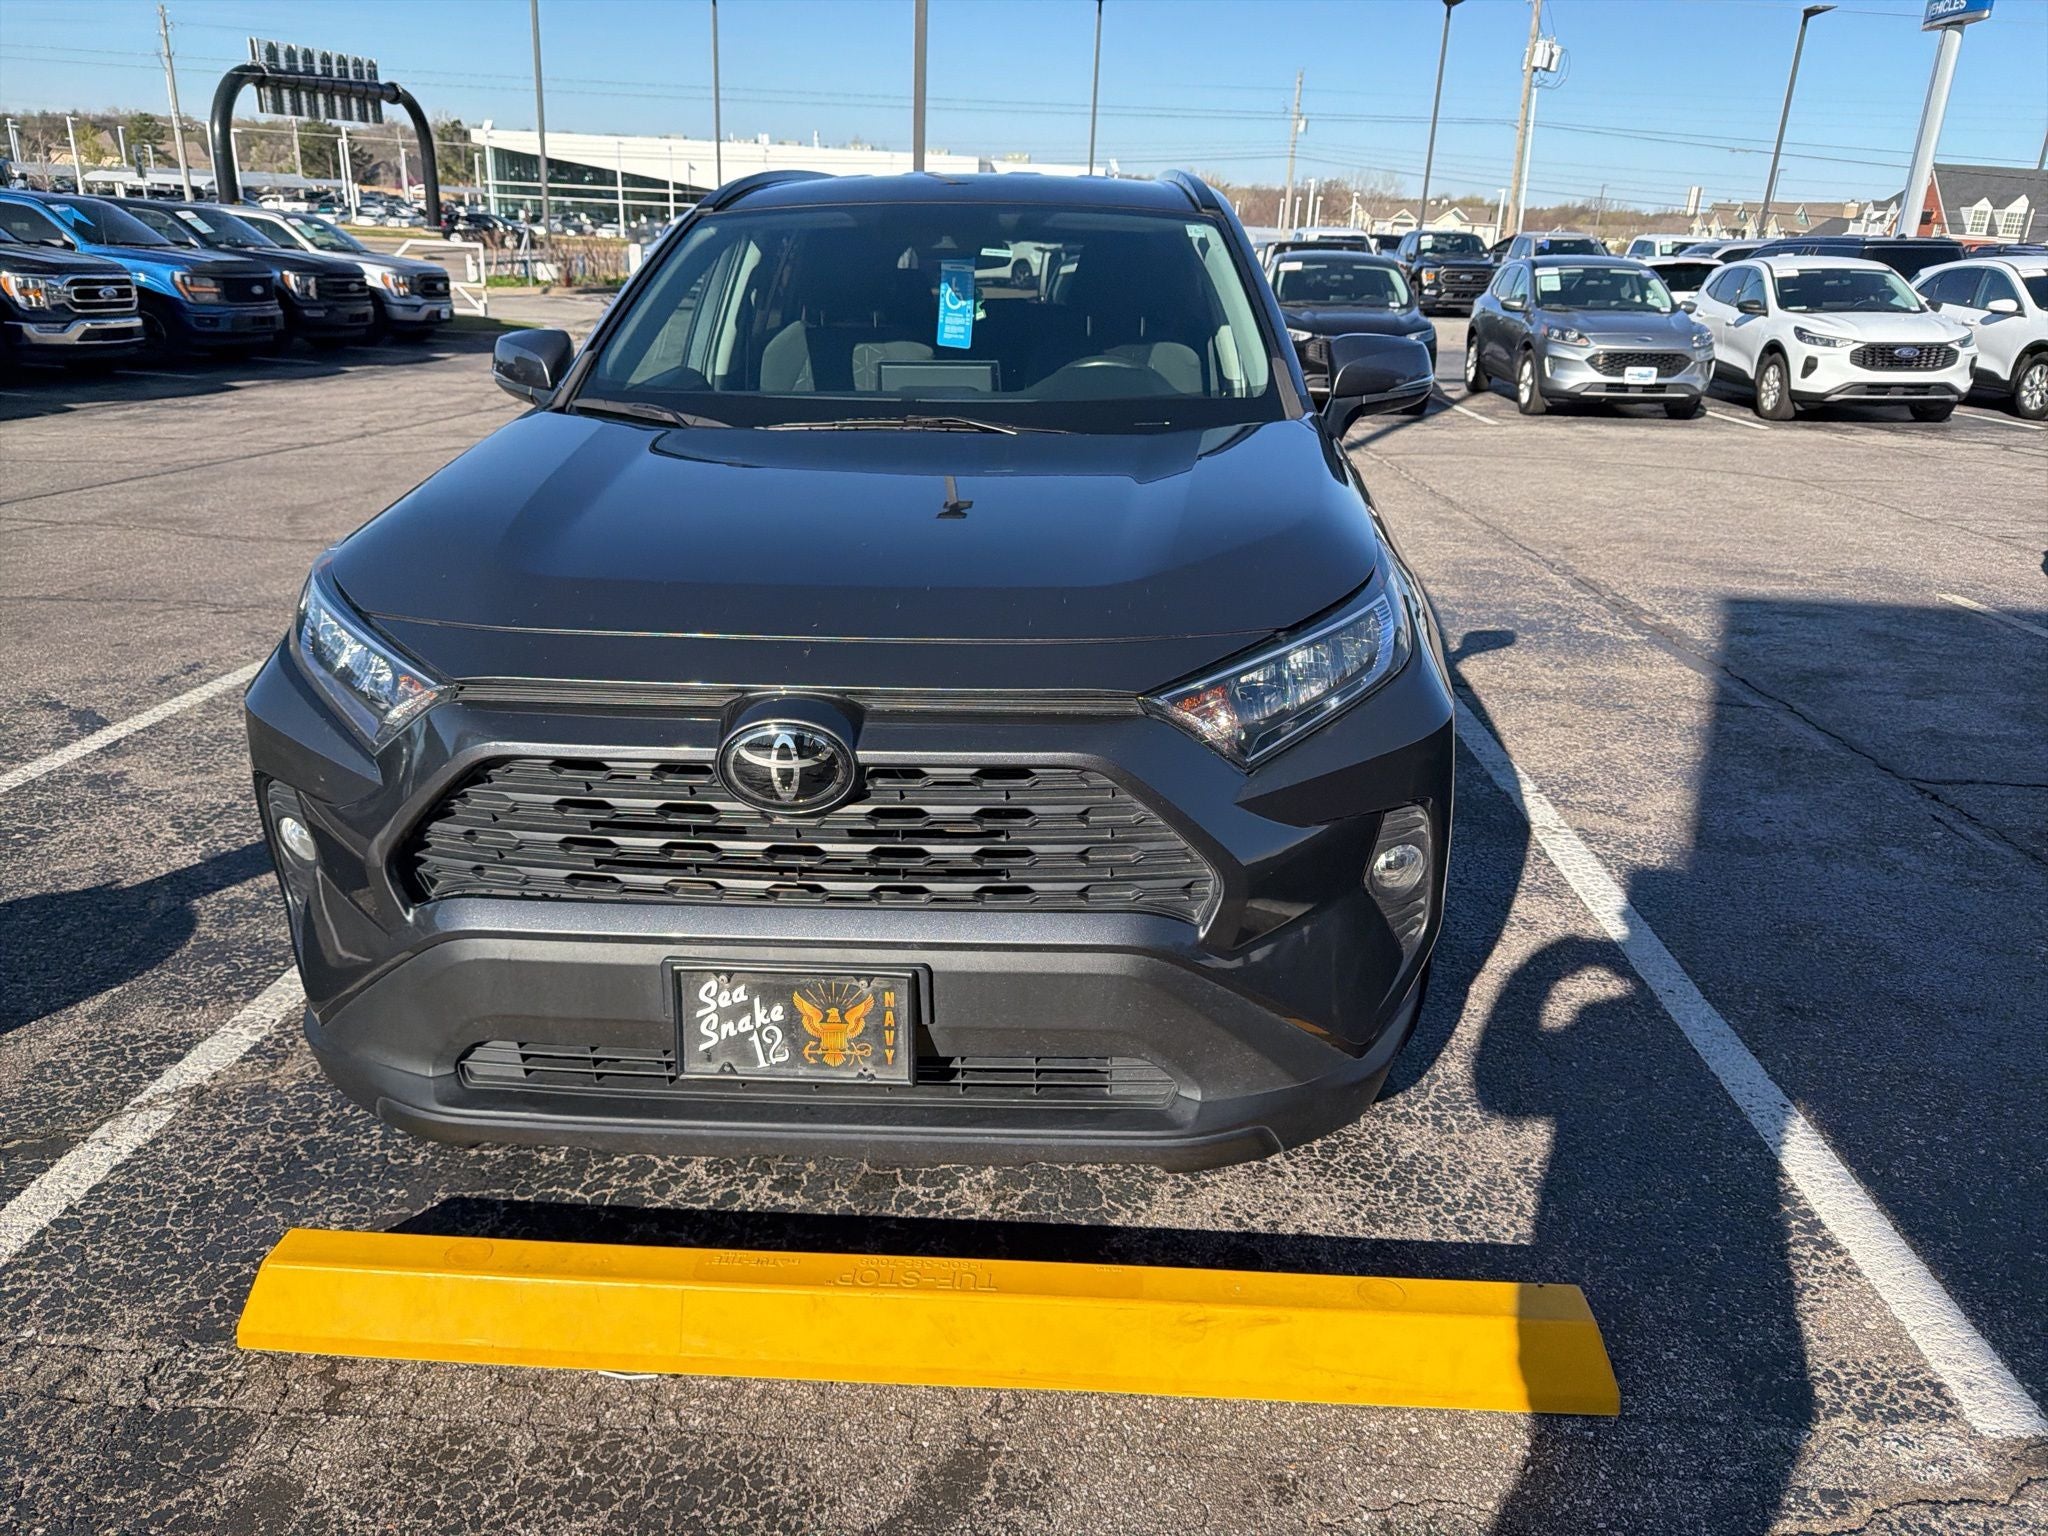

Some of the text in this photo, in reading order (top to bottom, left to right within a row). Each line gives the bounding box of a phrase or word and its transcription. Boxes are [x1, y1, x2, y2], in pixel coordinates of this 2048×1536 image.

[1928, 0, 1967, 16] VEHICLES
[696, 979, 748, 1017] Sea
[698, 995, 785, 1051] Snake
[884, 991, 895, 1065] NAVY
[748, 1025, 790, 1068] 12
